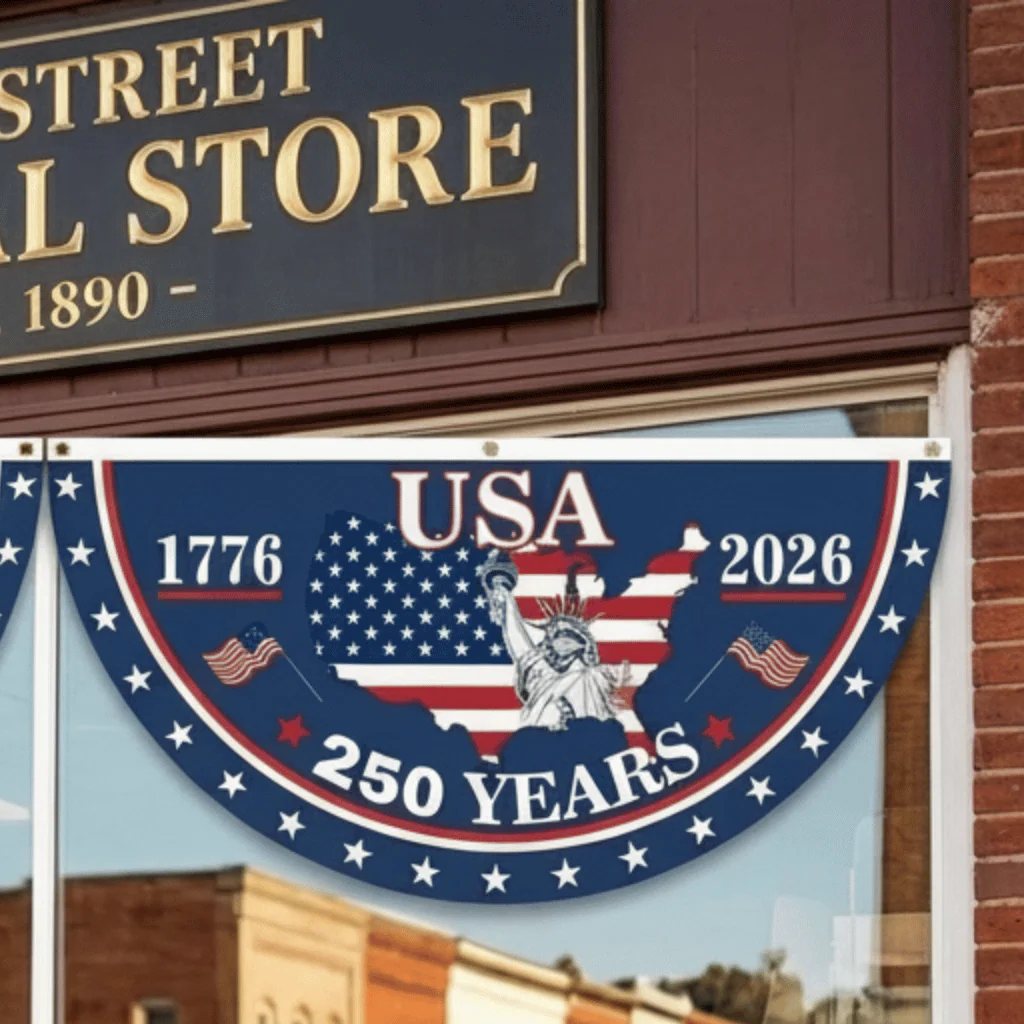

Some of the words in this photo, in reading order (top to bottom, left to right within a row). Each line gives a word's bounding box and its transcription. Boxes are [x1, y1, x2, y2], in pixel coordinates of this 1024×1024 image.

[127, 88, 537, 245] STORE
[25, 271, 149, 332] 1890
[391, 471, 615, 548] USA
[158, 534, 283, 585] 1776
[720, 533, 853, 585] 2026
[311, 733, 444, 817] 250
[463, 722, 700, 825] YEARS
